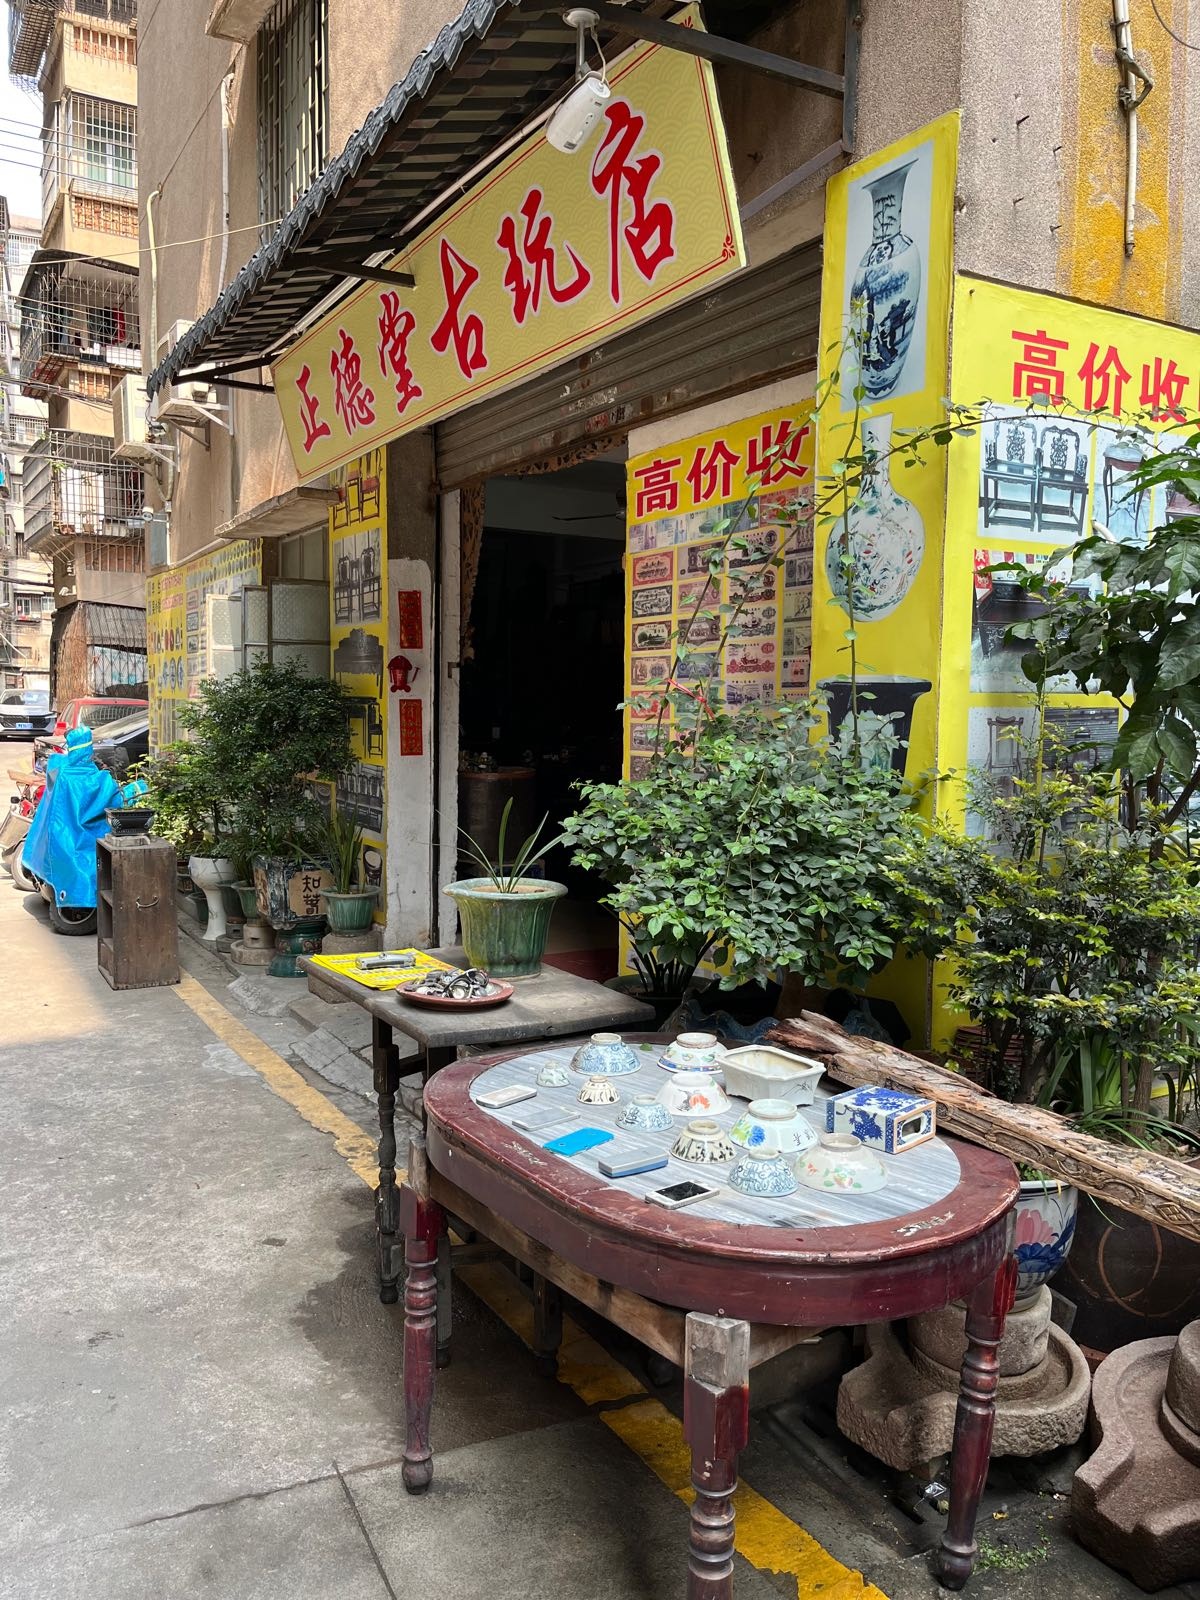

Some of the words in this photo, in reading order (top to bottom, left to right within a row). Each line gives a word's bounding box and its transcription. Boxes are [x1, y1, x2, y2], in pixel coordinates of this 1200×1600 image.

[295, 101, 675, 453] 正德堂古玩店
[1012, 329, 1200, 426] 高价收
[634, 420, 810, 518] 高价收
